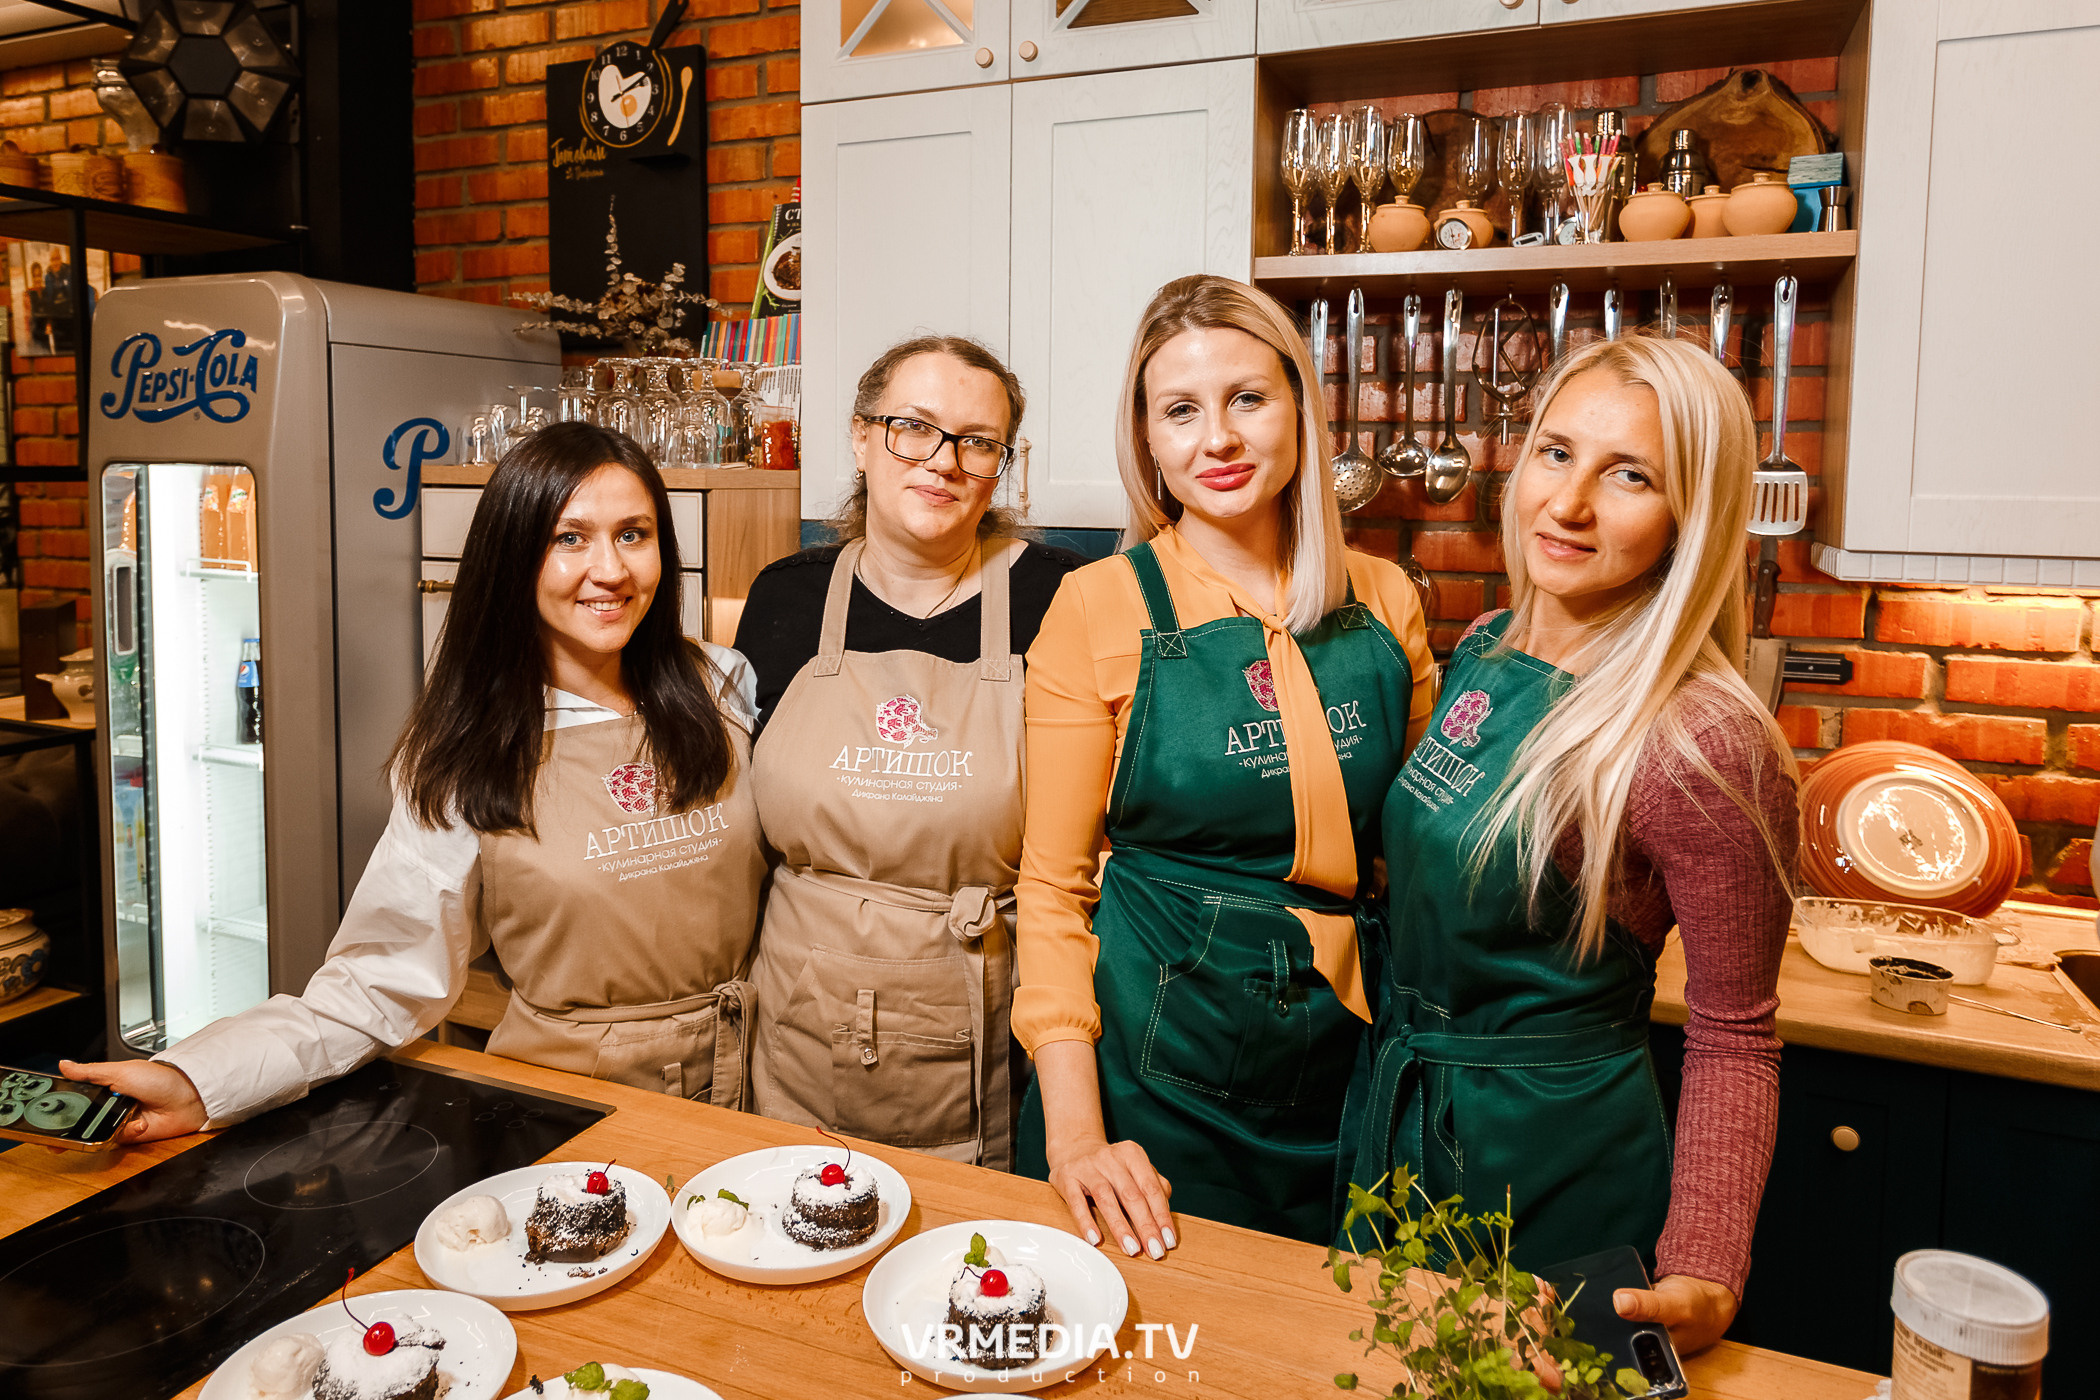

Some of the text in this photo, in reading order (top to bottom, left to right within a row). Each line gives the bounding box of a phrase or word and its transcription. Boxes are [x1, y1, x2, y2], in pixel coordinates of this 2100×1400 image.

[616, 45, 628, 57] 12
[636, 50, 641, 60] 1
[601, 54, 611, 65] 11
[591, 69, 601, 81] 10
[652, 84, 659, 95] 3
[587, 92, 595, 103] 9
[647, 105, 654, 116] 4
[590, 111, 598, 123] 8
[602, 125, 610, 136] 7
[636, 121, 644, 133] 5
[620, 130, 627, 141] 6
[1224, 700, 1367, 755] АРТОК
[829, 745, 973, 777] АРТИШОК
[840, 775, 958, 793] кулинарная студия
[584, 802, 729, 860] АРТИШОК
[602, 837, 718, 872] кулинарная студия
